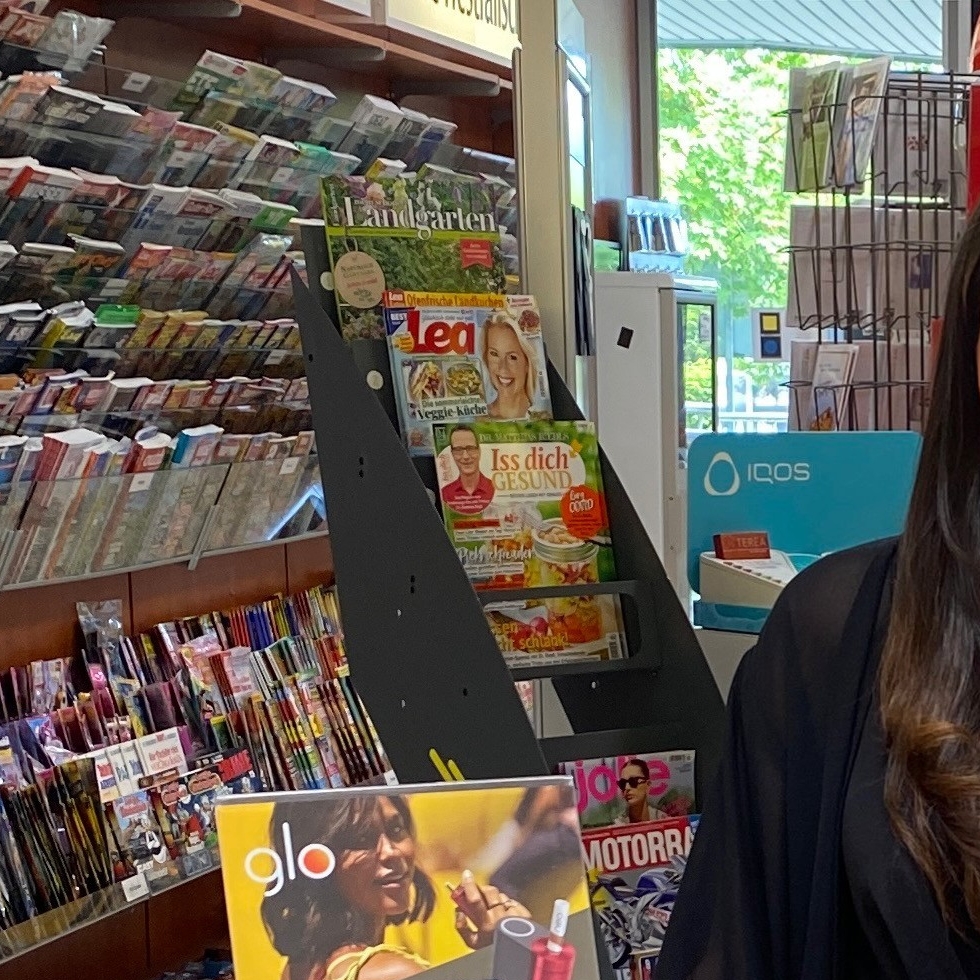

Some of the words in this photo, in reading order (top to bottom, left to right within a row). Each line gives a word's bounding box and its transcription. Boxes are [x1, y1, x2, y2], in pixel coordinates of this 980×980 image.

[407, 310, 475, 355] Lea
[417, 402, 488, 421] Veggie-Küche
[490, 448, 520, 471] Iss
[524, 445, 570, 471] dich
[492, 470, 573, 491] GESUND
[747, 462, 811, 484] IQOS
[736, 536, 767, 548] TEREA
[244, 822, 335, 898] glo
